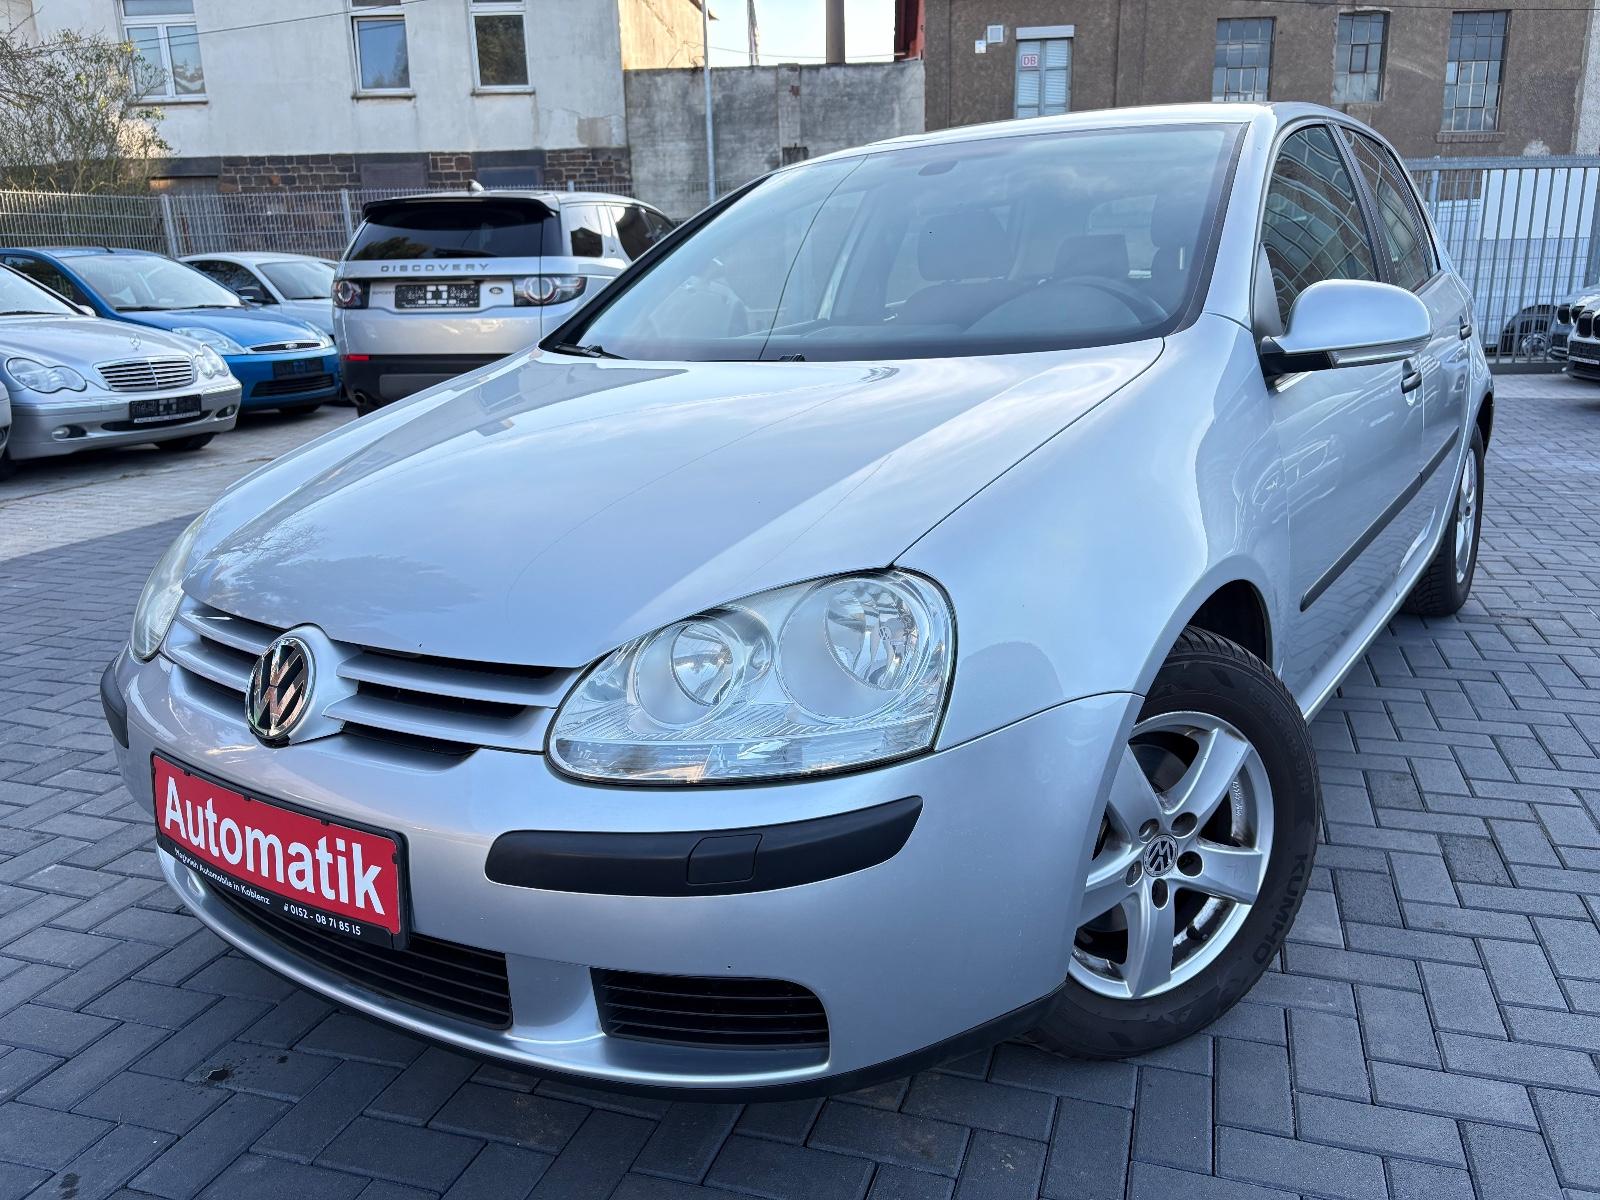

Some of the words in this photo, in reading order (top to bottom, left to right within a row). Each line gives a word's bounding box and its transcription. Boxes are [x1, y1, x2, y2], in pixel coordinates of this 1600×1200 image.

[1023, 56, 1036, 65] DB
[381, 263, 489, 273] DISCOVERY
[248, 639, 312, 736] VW
[164, 776, 386, 915] Automatik
[200, 865, 233, 888] Automobile
[233, 881, 240, 892] in
[240, 884, 270, 905] Koblenz
[290, 904, 309, 919] 0152
[315, 913, 327, 925] 08
[328, 917, 337, 929] 71
[339, 920, 350, 932] 85
[352, 924, 361, 936] 15
[1252, 853, 1308, 965] KUMHO
